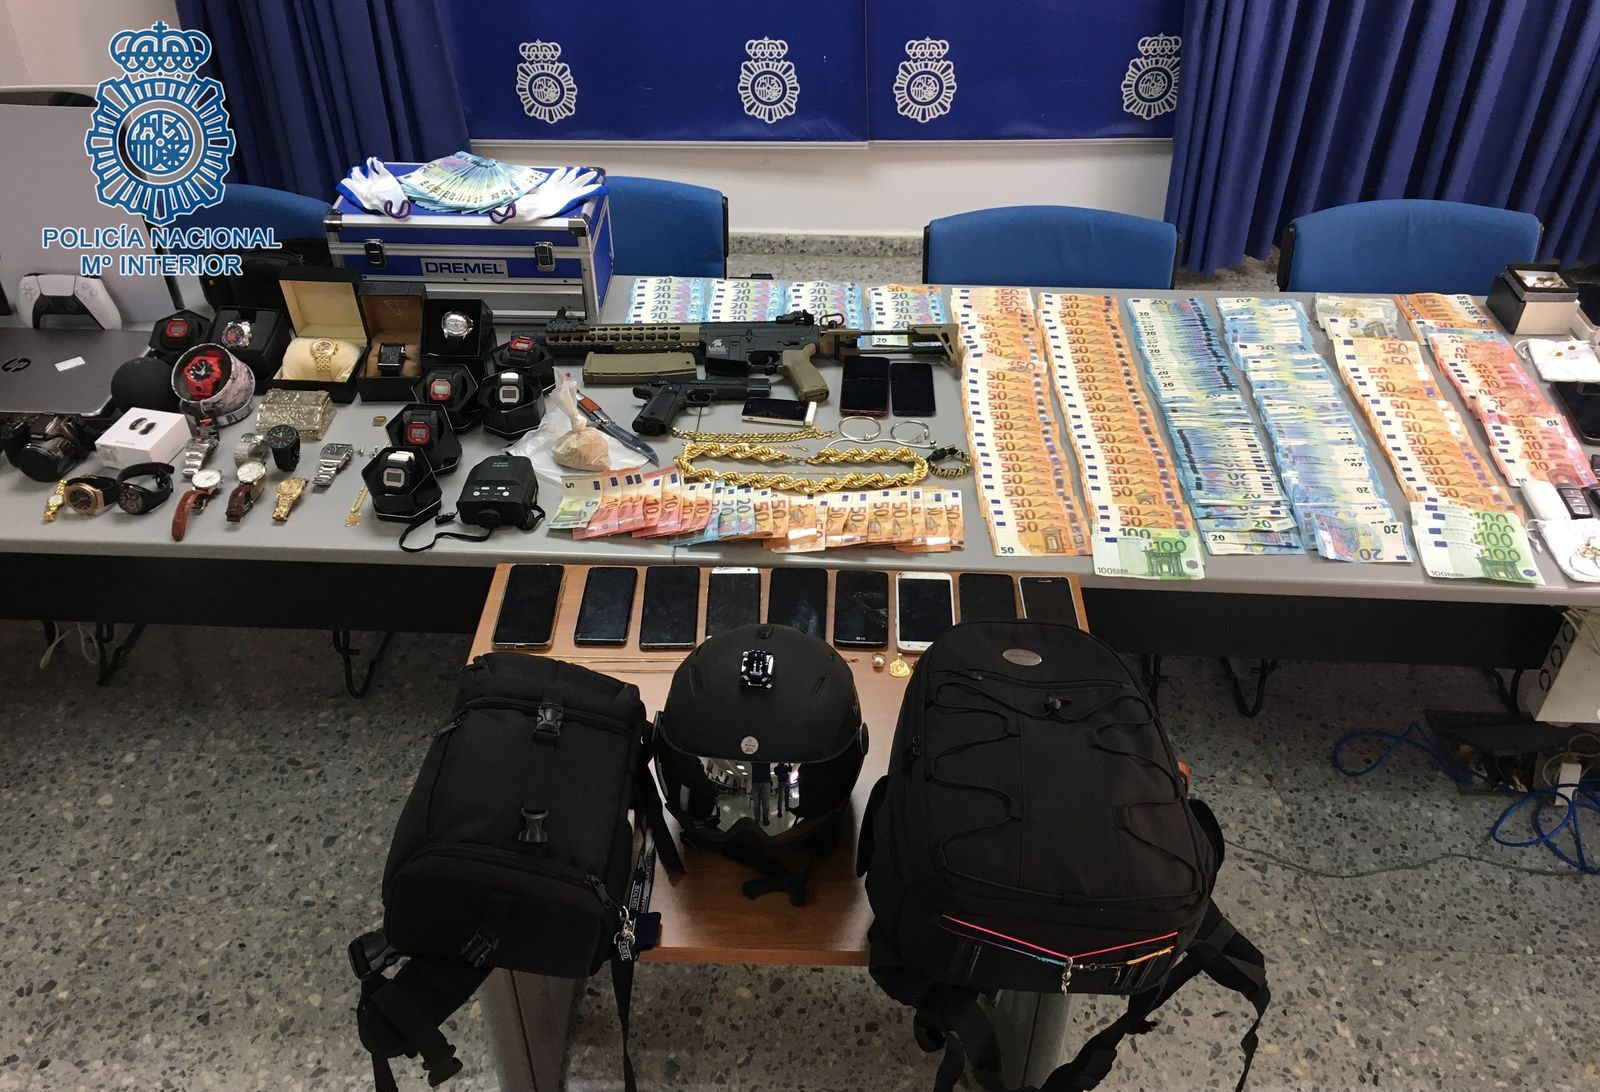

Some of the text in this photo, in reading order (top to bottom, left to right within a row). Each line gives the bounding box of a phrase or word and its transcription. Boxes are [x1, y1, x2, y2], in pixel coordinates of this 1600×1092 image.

[425, 262, 505, 275] DREMEL
[1061, 302, 1079, 310] 50
[650, 312, 667, 320] 20
[1058, 310, 1077, 318] 50
[1350, 320, 1358, 328] 5
[1066, 327, 1083, 335] 50
[1070, 346, 1088, 354] 50
[1072, 355, 1090, 364] 50
[1075, 365, 1094, 374] 50
[987, 371, 1006, 381] 50
[1076, 375, 1096, 384] 50
[1376, 382, 1396, 392] 50
[1483, 380, 1499, 388] 10
[988, 390, 1007, 400] 50
[1082, 392, 1102, 401] 50
[1086, 403, 1106, 413] 50
[1390, 400, 1410, 410] 50
[990, 411, 1010, 421] 50
[994, 421, 1013, 430] 50
[1091, 423, 1111, 432] 50
[1402, 421, 1422, 433] 50
[1095, 433, 1116, 444] 50
[1406, 434, 1427, 445] 50
[995, 441, 1016, 452] 50
[1524, 441, 1543, 450] 10
[1411, 447, 1434, 456] 50
[1524, 451, 1542, 460] 10
[999, 453, 1019, 462] 50
[1104, 454, 1125, 465] 50
[1416, 456, 1440, 466] 50
[1001, 463, 1022, 473] 50
[1422, 466, 1446, 476] 50
[1530, 461, 1549, 471] 10
[1002, 474, 1023, 484] 50
[1108, 476, 1130, 485] 50
[1426, 477, 1450, 486] 50
[1004, 486, 1025, 497] 50
[1110, 486, 1133, 497] 50
[1436, 487, 1459, 499] 50
[646, 499, 659, 514] 10
[665, 495, 678, 508] 10
[696, 500, 709, 513] 10
[737, 498, 751, 513] 20
[1010, 498, 1032, 508] 50
[754, 502, 769, 521] 50
[771, 500, 786, 519] 50
[850, 507, 866, 522] 50
[874, 502, 889, 517] 50
[893, 502, 908, 518] 50
[1013, 509, 1036, 520] 50
[1118, 506, 1140, 516] 50
[1016, 521, 1038, 532] 50
[1120, 517, 1143, 528] 50
[1252, 520, 1272, 529] 20
[1384, 525, 1398, 534] 20
[1478, 532, 1513, 547] 100
[1153, 540, 1187, 553] 100
[1359, 548, 1384, 561] 20
[1484, 549, 1521, 562] 100
